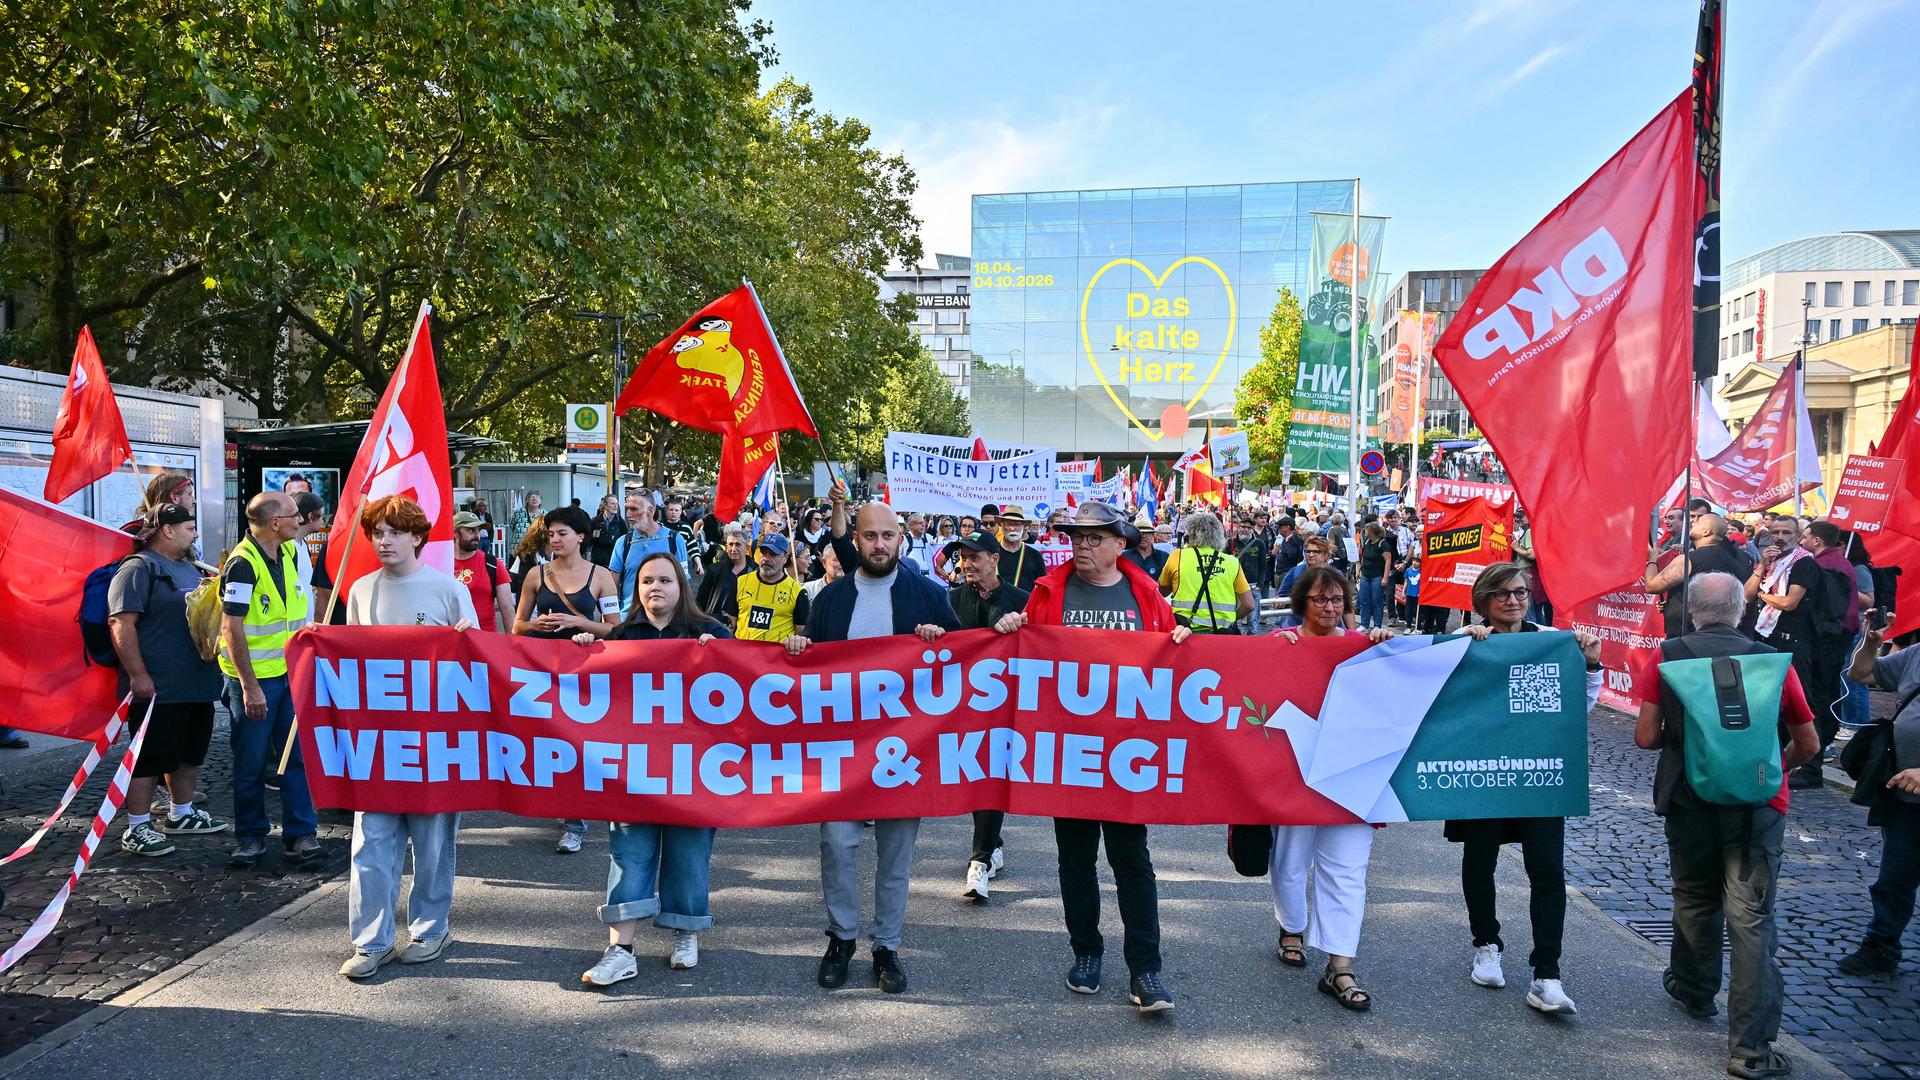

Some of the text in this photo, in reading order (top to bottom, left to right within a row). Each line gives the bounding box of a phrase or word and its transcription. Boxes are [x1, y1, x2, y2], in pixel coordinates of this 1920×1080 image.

[974, 275, 1054, 289] 04.10.2026
[1126, 292, 1190, 318] Das
[1115, 325, 1200, 350] kalte
[1119, 357, 1195, 383] Herz
[892, 451, 1049, 484] FRIEDEN jetzt!
[1060, 463, 1088, 473] NEIN!
[1848, 457, 1885, 468] Frieden
[1845, 468, 1861, 476] mit
[894, 477, 934, 487] Milliarden
[965, 484, 987, 492] gutes
[1842, 478, 1885, 489] Russland
[928, 488, 954, 498] KRIEG,
[1838, 488, 1889, 500] und China!
[1853, 521, 1880, 532] DKP
[1429, 535, 1443, 551] EU
[1451, 528, 1480, 547] KRIEG
[752, 610, 771, 625] 1&1
[1063, 610, 1125, 624] RADIKAL
[1608, 669, 1632, 693] DKP
[315, 648, 1241, 730] NEIN ZU HOCHRÜSTUNG,
[314, 726, 1187, 796] WEHRPFLICHT & KRIEG!
[1416, 756, 1564, 773] AKTIONSBÜNDNIS
[1417, 771, 1564, 790] 3. OKTOBER 2026
